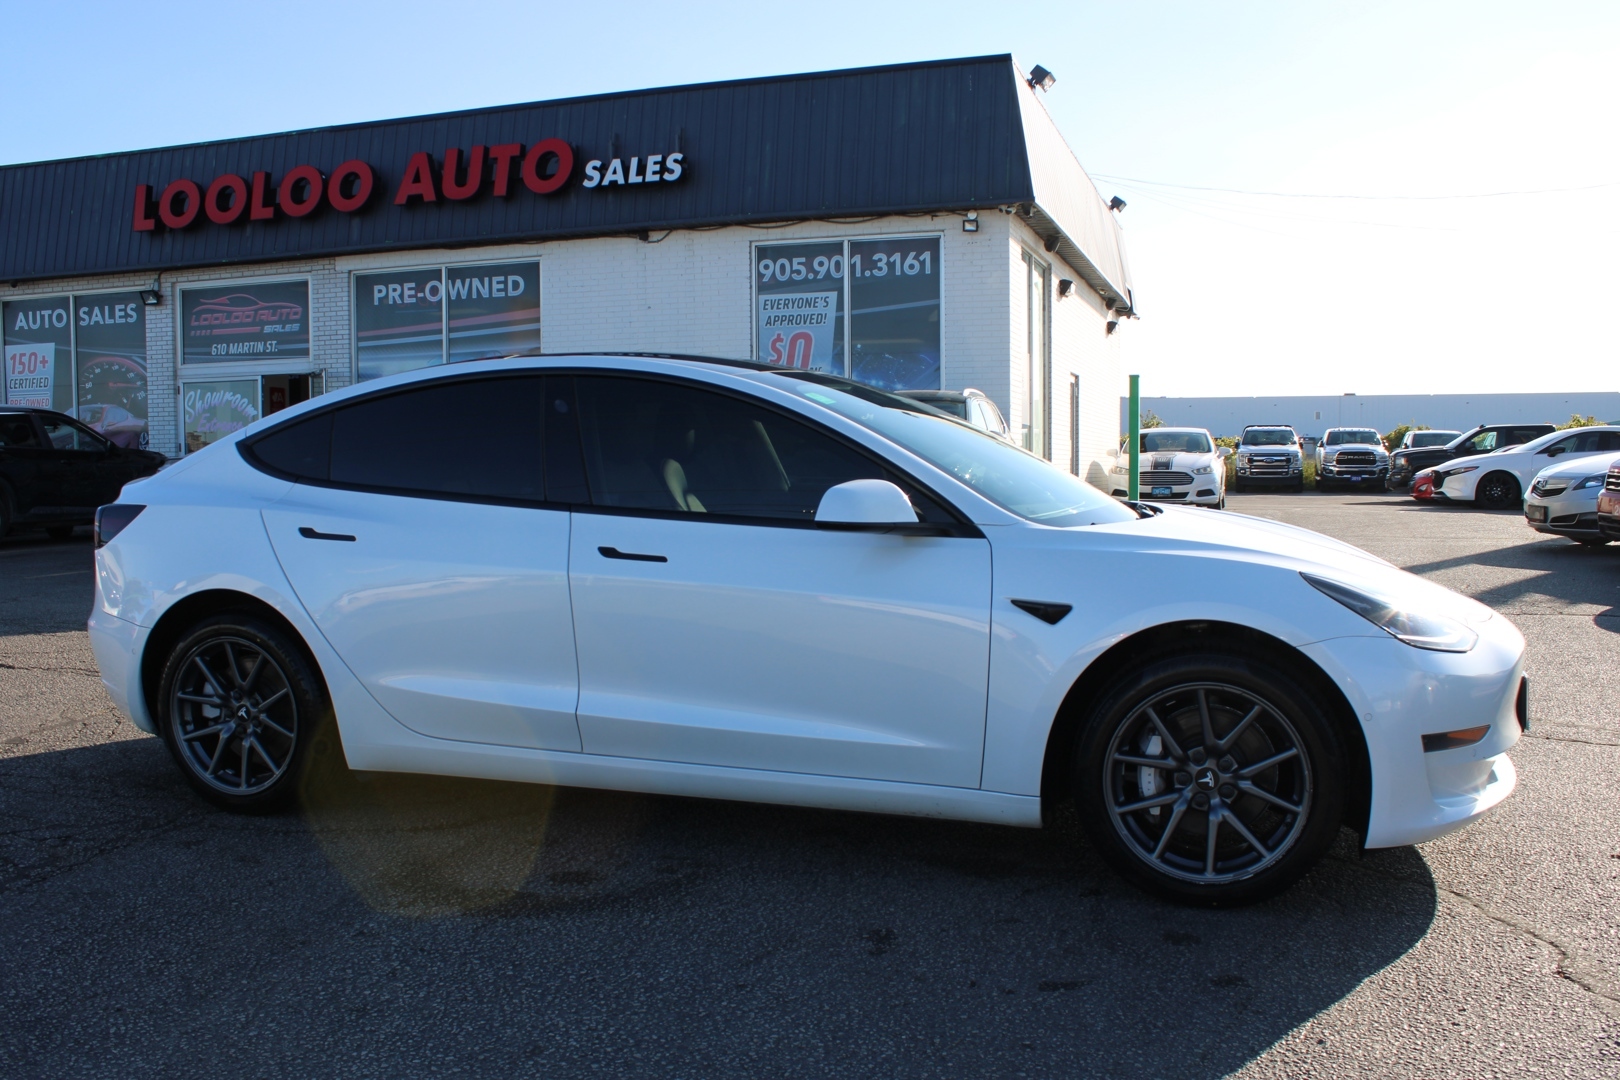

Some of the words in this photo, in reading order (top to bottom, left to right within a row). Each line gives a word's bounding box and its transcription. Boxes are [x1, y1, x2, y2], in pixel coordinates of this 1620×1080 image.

[133, 160, 374, 232] LOOLOO
[393, 137, 574, 205] AUTO
[583, 152, 684, 188] SALES
[758, 250, 931, 282] 905.901.3161
[373, 275, 525, 306] PRE-OWNED
[762, 296, 829, 311] EVERYONE'S
[15, 308, 67, 330] AUTO
[79, 303, 137, 327] SALES
[190, 311, 254, 326] LOOLOO
[256, 308, 302, 321] AUTO
[765, 313, 827, 327] APPROVED!
[263, 324, 300, 333] SALES
[211, 344, 227, 355] 610
[229, 342, 264, 354] MARTIN
[266, 341, 278, 352] ST.
[10, 352, 49, 375] 150+
[9, 377, 49, 389] CERTIFIED
[185, 389, 258, 422] Showroom
